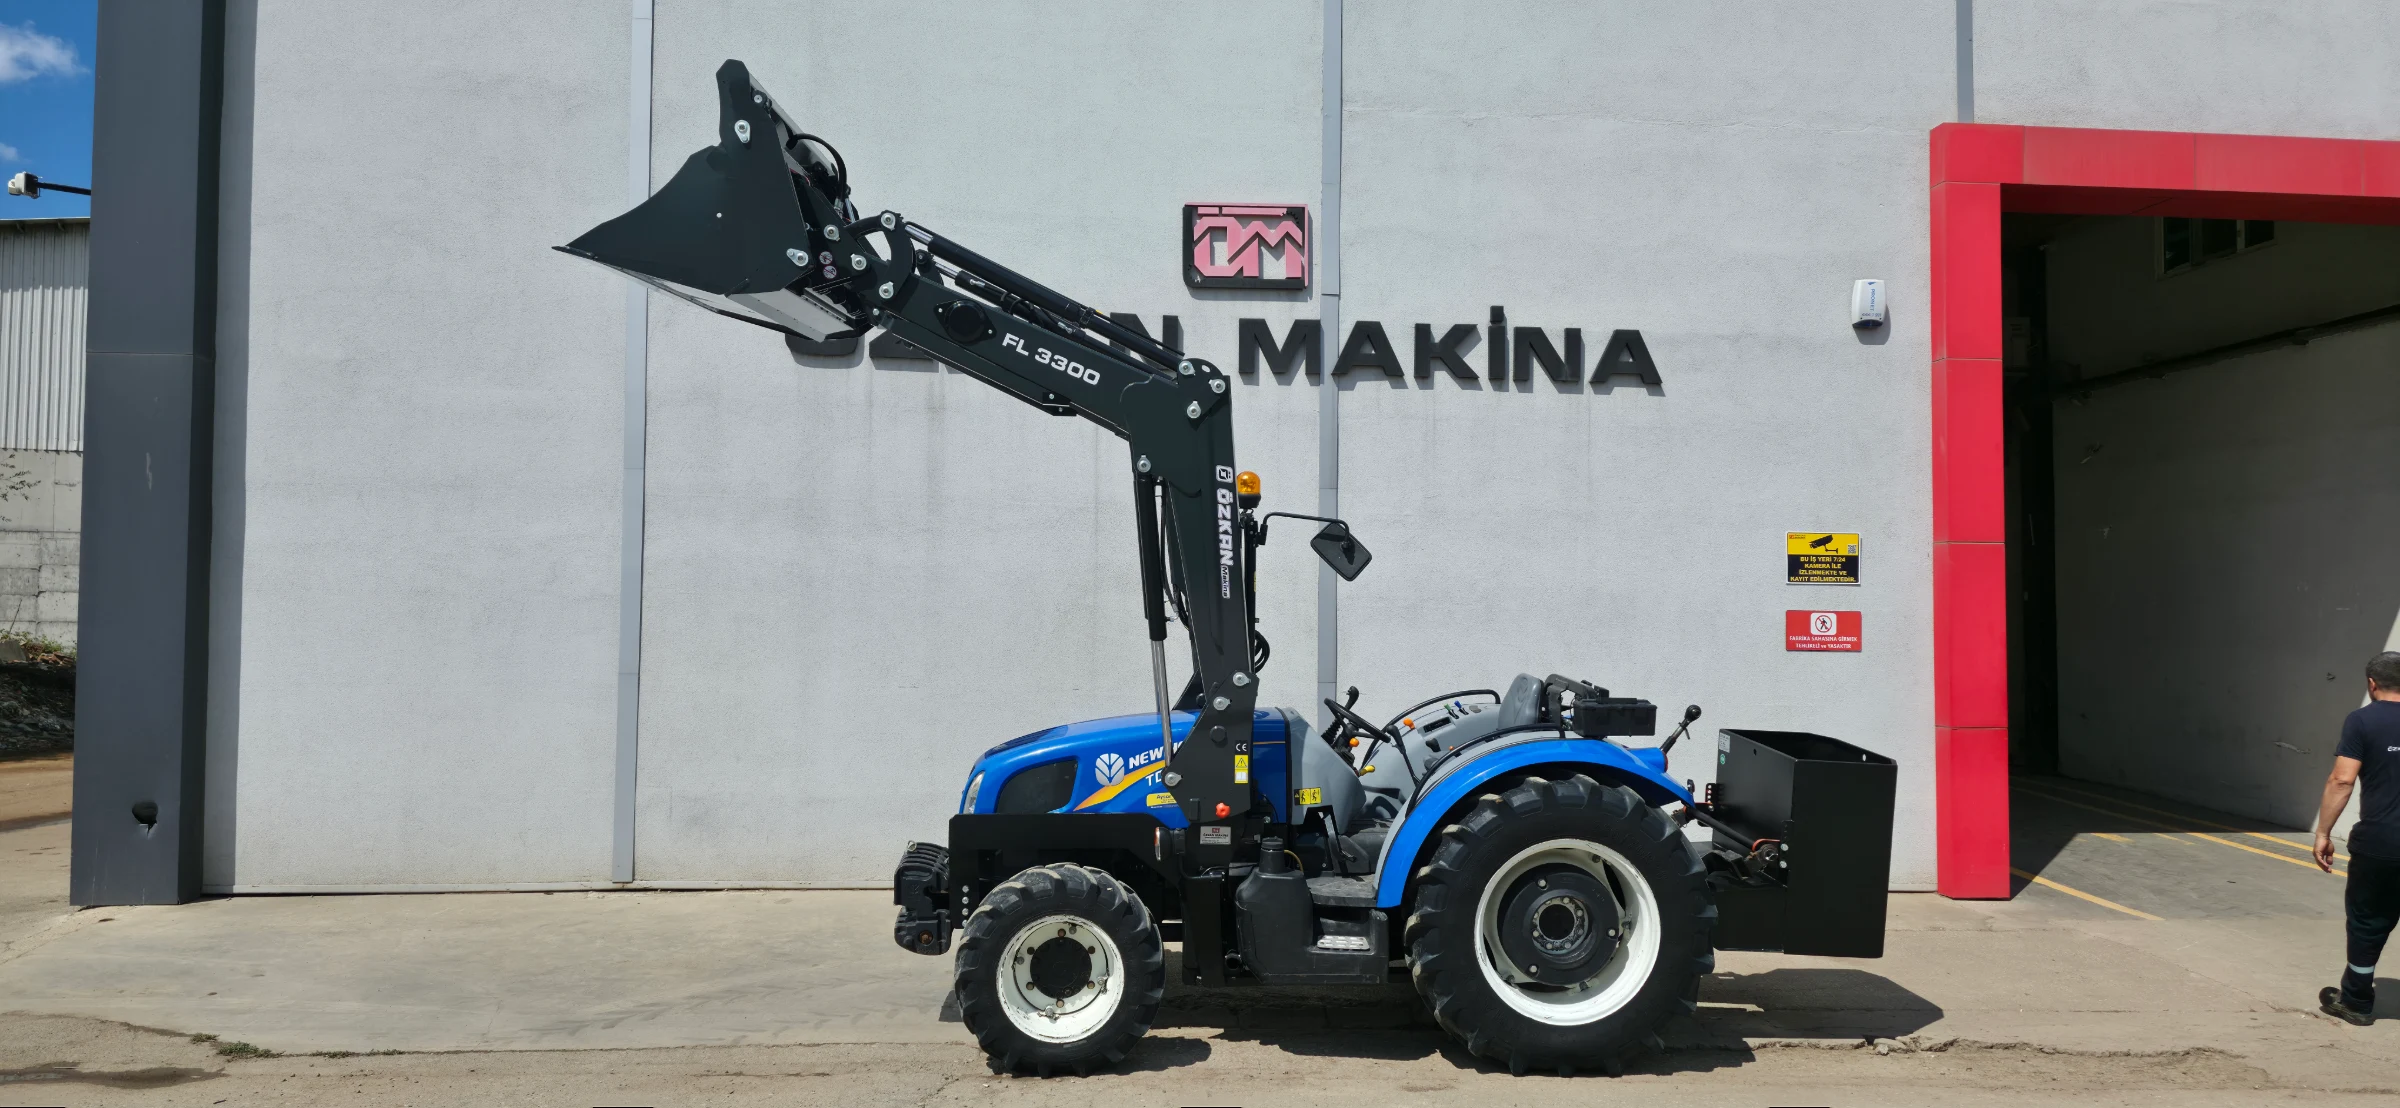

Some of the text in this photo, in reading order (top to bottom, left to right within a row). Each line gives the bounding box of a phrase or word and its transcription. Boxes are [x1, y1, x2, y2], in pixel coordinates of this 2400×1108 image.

[1001, 332, 1029, 356] FL
[1034, 347, 1101, 386] 3300
[1238, 305, 1663, 385] MAKİNA
[1216, 488, 1234, 566] ÖZKAN
[1221, 566, 1230, 598] Makina
[1128, 746, 1164, 769] NEW
